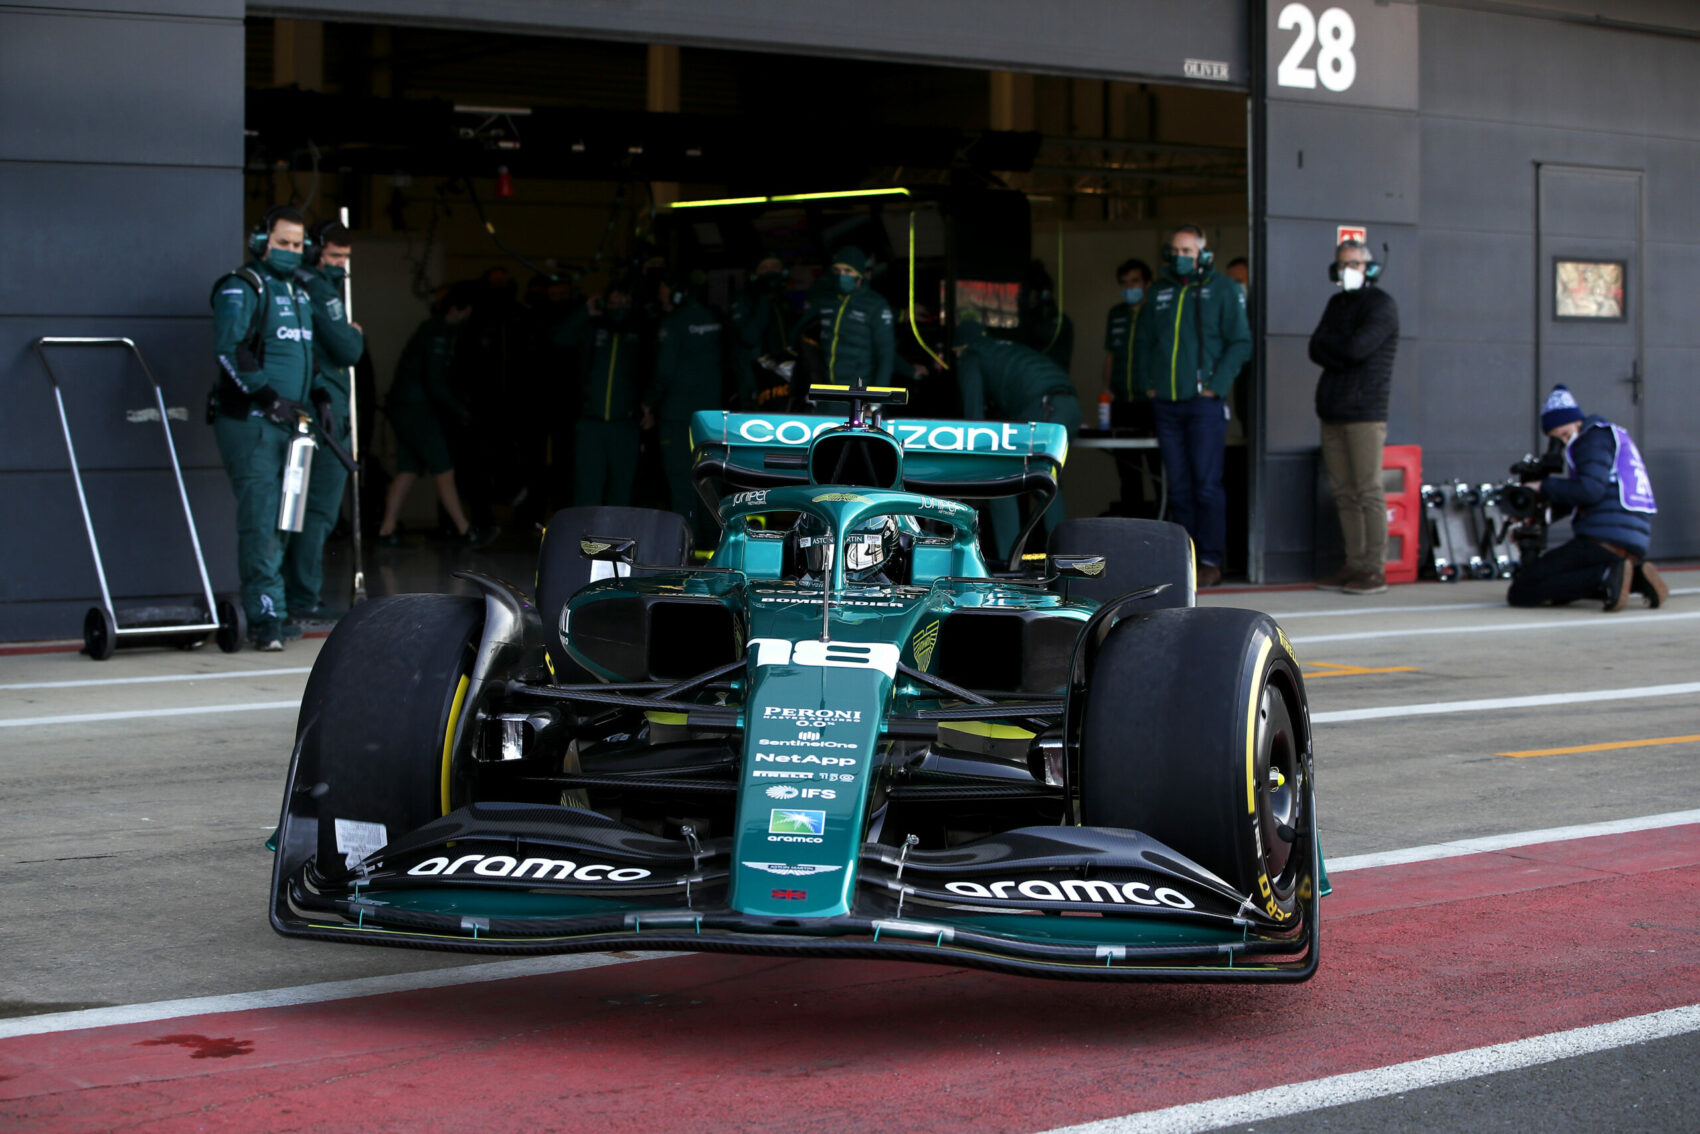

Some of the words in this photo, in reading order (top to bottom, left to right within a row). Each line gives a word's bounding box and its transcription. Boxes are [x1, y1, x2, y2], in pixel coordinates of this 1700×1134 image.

[1278, 3, 1356, 91] 28
[1184, 61, 1229, 78] OLIVER
[761, 597, 904, 608] BOMBARDIER
[746, 638, 900, 679] 18
[763, 706, 862, 719] PERONI
[759, 739, 858, 749] SentinelOne
[755, 753, 857, 767] NetApp
[752, 770, 814, 779] PIRELLI
[801, 788, 837, 800] IFS
[767, 835, 823, 844] aramco
[407, 854, 651, 882] aramco
[944, 880, 1195, 909] aramco
